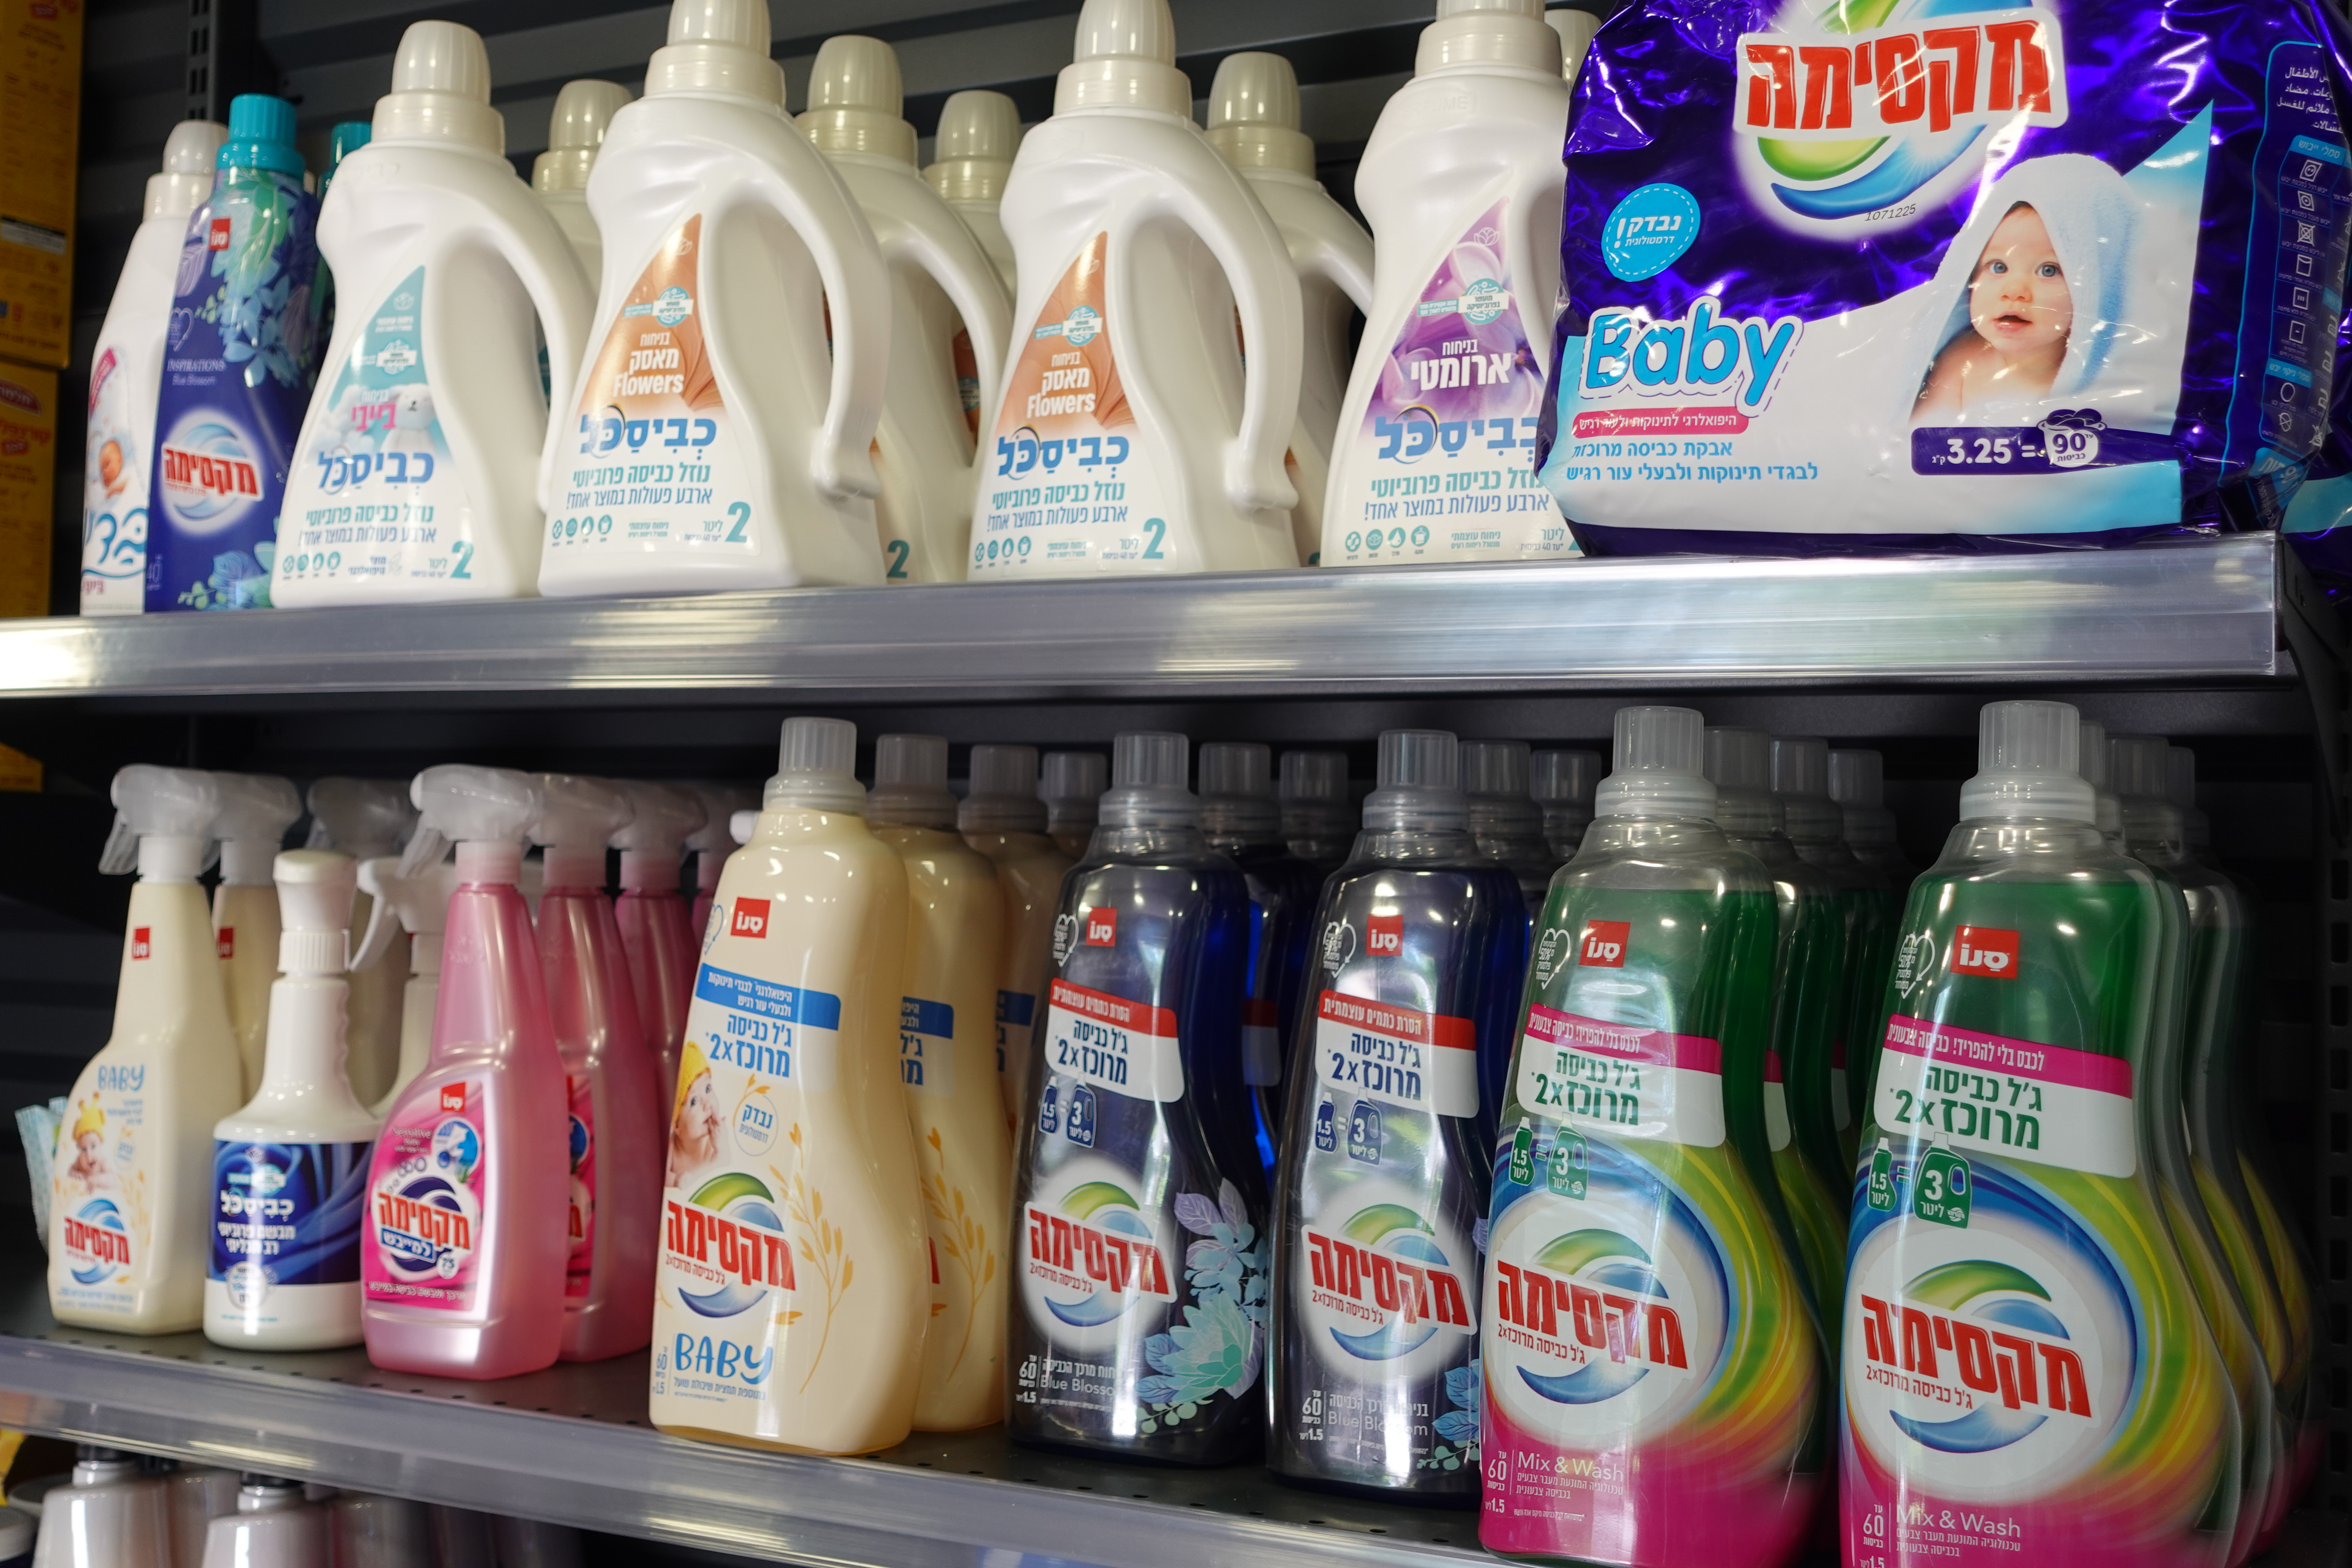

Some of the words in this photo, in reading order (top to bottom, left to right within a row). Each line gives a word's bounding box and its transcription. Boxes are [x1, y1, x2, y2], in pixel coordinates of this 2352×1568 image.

[1746, 20, 2052, 132] מקסימה
[2285, 67, 2318, 79] الأطفال
[2285, 83, 2309, 95] مضاد
[2306, 103, 2329, 114] ملائم
[1865, 203, 1916, 222] 1071225
[1625, 236, 1675, 248] דרמטולוגית
[1467, 302, 1500, 310] בפרוביוטיקה
[640, 332, 670, 346] בניחוח
[1442, 340, 1478, 355] בניחוח
[629, 349, 680, 375] מאסק
[1051, 352, 1081, 367] בניחוח
[1586, 302, 1795, 406] Baby
[1411, 352, 1512, 391] ארומטי
[612, 372, 684, 397] Flowers
[1042, 368, 1090, 395] מאסק
[1027, 393, 1096, 419] Flowers
[1579, 418, 1600, 429] רגיש
[1632, 415, 1678, 429] לתינוקות
[1682, 413, 1737, 426] היפואלרגי
[1572, 442, 1622, 458] מרוכזת
[1628, 442, 1676, 456] כביסה
[1684, 442, 1732, 459] אבקת
[1947, 438, 2012, 464] 3.25
[2053, 433, 2086, 454] 90
[2056, 453, 2086, 462] כביסות
[163, 448, 257, 497] מקסימה
[573, 466, 624, 488] פרוביוטי
[628, 464, 674, 483] כביסה
[679, 462, 711, 483] נוזל
[1446, 470, 1501, 491] כביסה
[1566, 466, 1601, 480] רגיש
[1607, 466, 1632, 480] עור
[1638, 463, 1691, 480] ולבעלי
[1697, 465, 1761, 483] תינוקות
[1767, 462, 1818, 480] לבגדי
[628, 486, 672, 504] פעולות
[1045, 483, 1088, 504] כביסה
[1095, 481, 1124, 501] נוזל
[1372, 474, 1439, 497] פרוביוטי
[594, 489, 624, 506] במוצר
[675, 488, 712, 504] ארבע
[992, 487, 1039, 510] פרוביוטי
[1448, 494, 1501, 514] פעולות
[1507, 494, 1549, 511] ארבע
[306, 506, 350, 527] פרוביוטי
[355, 504, 398, 523] כביסה
[1046, 506, 1087, 525] פעולות
[1092, 506, 1127, 523] ארבע
[1365, 502, 1398, 520] אחד!
[1403, 499, 1443, 517] במוצר
[703, 520, 723, 532] ליטר
[725, 502, 751, 543] 2
[1014, 511, 1042, 527] במוצר
[355, 527, 397, 542] פעולות
[1142, 518, 1166, 559] 2
[1481, 531, 1501, 539] ניחוח
[1541, 527, 1564, 540] ליטר
[450, 540, 473, 579] 2
[888, 540, 909, 578] 2
[736, 911, 763, 934] סנו
[1090, 921, 1112, 941] סנו
[1587, 937, 1620, 961] סנו
[1960, 944, 2009, 971] סנו
[1324, 998, 1365, 1022] עוצמתית
[727, 1014, 767, 1040] כביסה
[1367, 1011, 1394, 1029] כתמים
[1397, 1016, 1421, 1035] הסרת
[1528, 1013, 1552, 1034] צבעונית
[1552, 1020, 1574, 1039] כביסה
[1074, 1020, 1107, 1048] כביסה
[1606, 1029, 1619, 1049] בלי
[1887, 1024, 1917, 1046] צבעונית
[1918, 1031, 1949, 1053] כביסה
[1351, 1033, 1394, 1061] כביסה
[1620, 1035, 1640, 1053] לכבס
[1953, 1038, 1995, 1062] להפריד!
[1998, 1044, 2014, 1066] בלי
[2017, 1050, 2045, 1071] לכבס
[1556, 1051, 1608, 1083] כביסה
[98, 1064, 144, 1092] BABY
[1925, 1066, 2000, 1102] כביסה
[742, 1105, 773, 1129] נבדק
[1071, 1101, 1082, 1125] 3
[393, 1127, 432, 1139] Sensitive
[1317, 1119, 1331, 1135] 1.5
[1354, 1118, 1365, 1142] 3
[1514, 1147, 1526, 1166] 1.5
[1556, 1147, 1568, 1174] 3
[1513, 1165, 1528, 1180] ליטר
[1872, 1171, 1887, 1190] 1.5
[1552, 1176, 1569, 1191] ליטר
[1924, 1170, 1942, 1200] 3
[1871, 1191, 1890, 1206] ליטר
[1920, 1202, 1944, 1217] ליטר
[377, 1193, 469, 1249] מקסימה
[65, 1216, 129, 1266] מקסימה
[668, 1200, 796, 1291] מקסימה
[1030, 1209, 1169, 1295] מקסימה
[442, 1258, 455, 1268] 75
[1308, 1232, 1470, 1326] מקסימה
[1346, 1302, 1369, 1320] כביסה
[1498, 1260, 1688, 1369] מקסימה
[1537, 1337, 1567, 1359] כביסה
[1861, 1294, 2092, 1418] מקסימה
[676, 1334, 773, 1384] BABY
[1019, 1362, 1037, 1379] 60
[1041, 1375, 1068, 1390] Blue
[1913, 1379, 1951, 1403] כביסה
[1302, 1397, 1322, 1415] 60
[1328, 1411, 1360, 1428] Blue
[1309, 1428, 1323, 1440] 1.5
[1488, 1459, 1507, 1480] 60
[1518, 1451, 1550, 1471] Mix
[1555, 1456, 1568, 1473] &
[1573, 1458, 1623, 1482] Wash
[1487, 1480, 1504, 1491] כביסות
[1517, 1473, 1538, 1483] צבעים
[1540, 1475, 1558, 1485] מעבר
[1560, 1477, 1587, 1489] המונעת
[1516, 1485, 1543, 1496] צבעונית
[1545, 1488, 1571, 1499] בכביסה
[1589, 1482, 1623, 1495] טכנולוגיה
[1491, 1498, 1504, 1513] 1.5
[1874, 1504, 1883, 1513] עד
[1863, 1514, 1883, 1537] 60
[1896, 1504, 1935, 1526] Mix
[1939, 1510, 1956, 1529] &
[1960, 1512, 2020, 1537] Wash
[1863, 1536, 1883, 1547] כביסות
[1896, 1528, 1920, 1539] צבעים
[1923, 1531, 1944, 1541] מעבר
[1947, 1533, 1978, 1546] המונעת
[1896, 1541, 1928, 1553] צבעונית
[1931, 1545, 1960, 1557] בכביסה
[1981, 1537, 2020, 1551] טכנולוגיה
